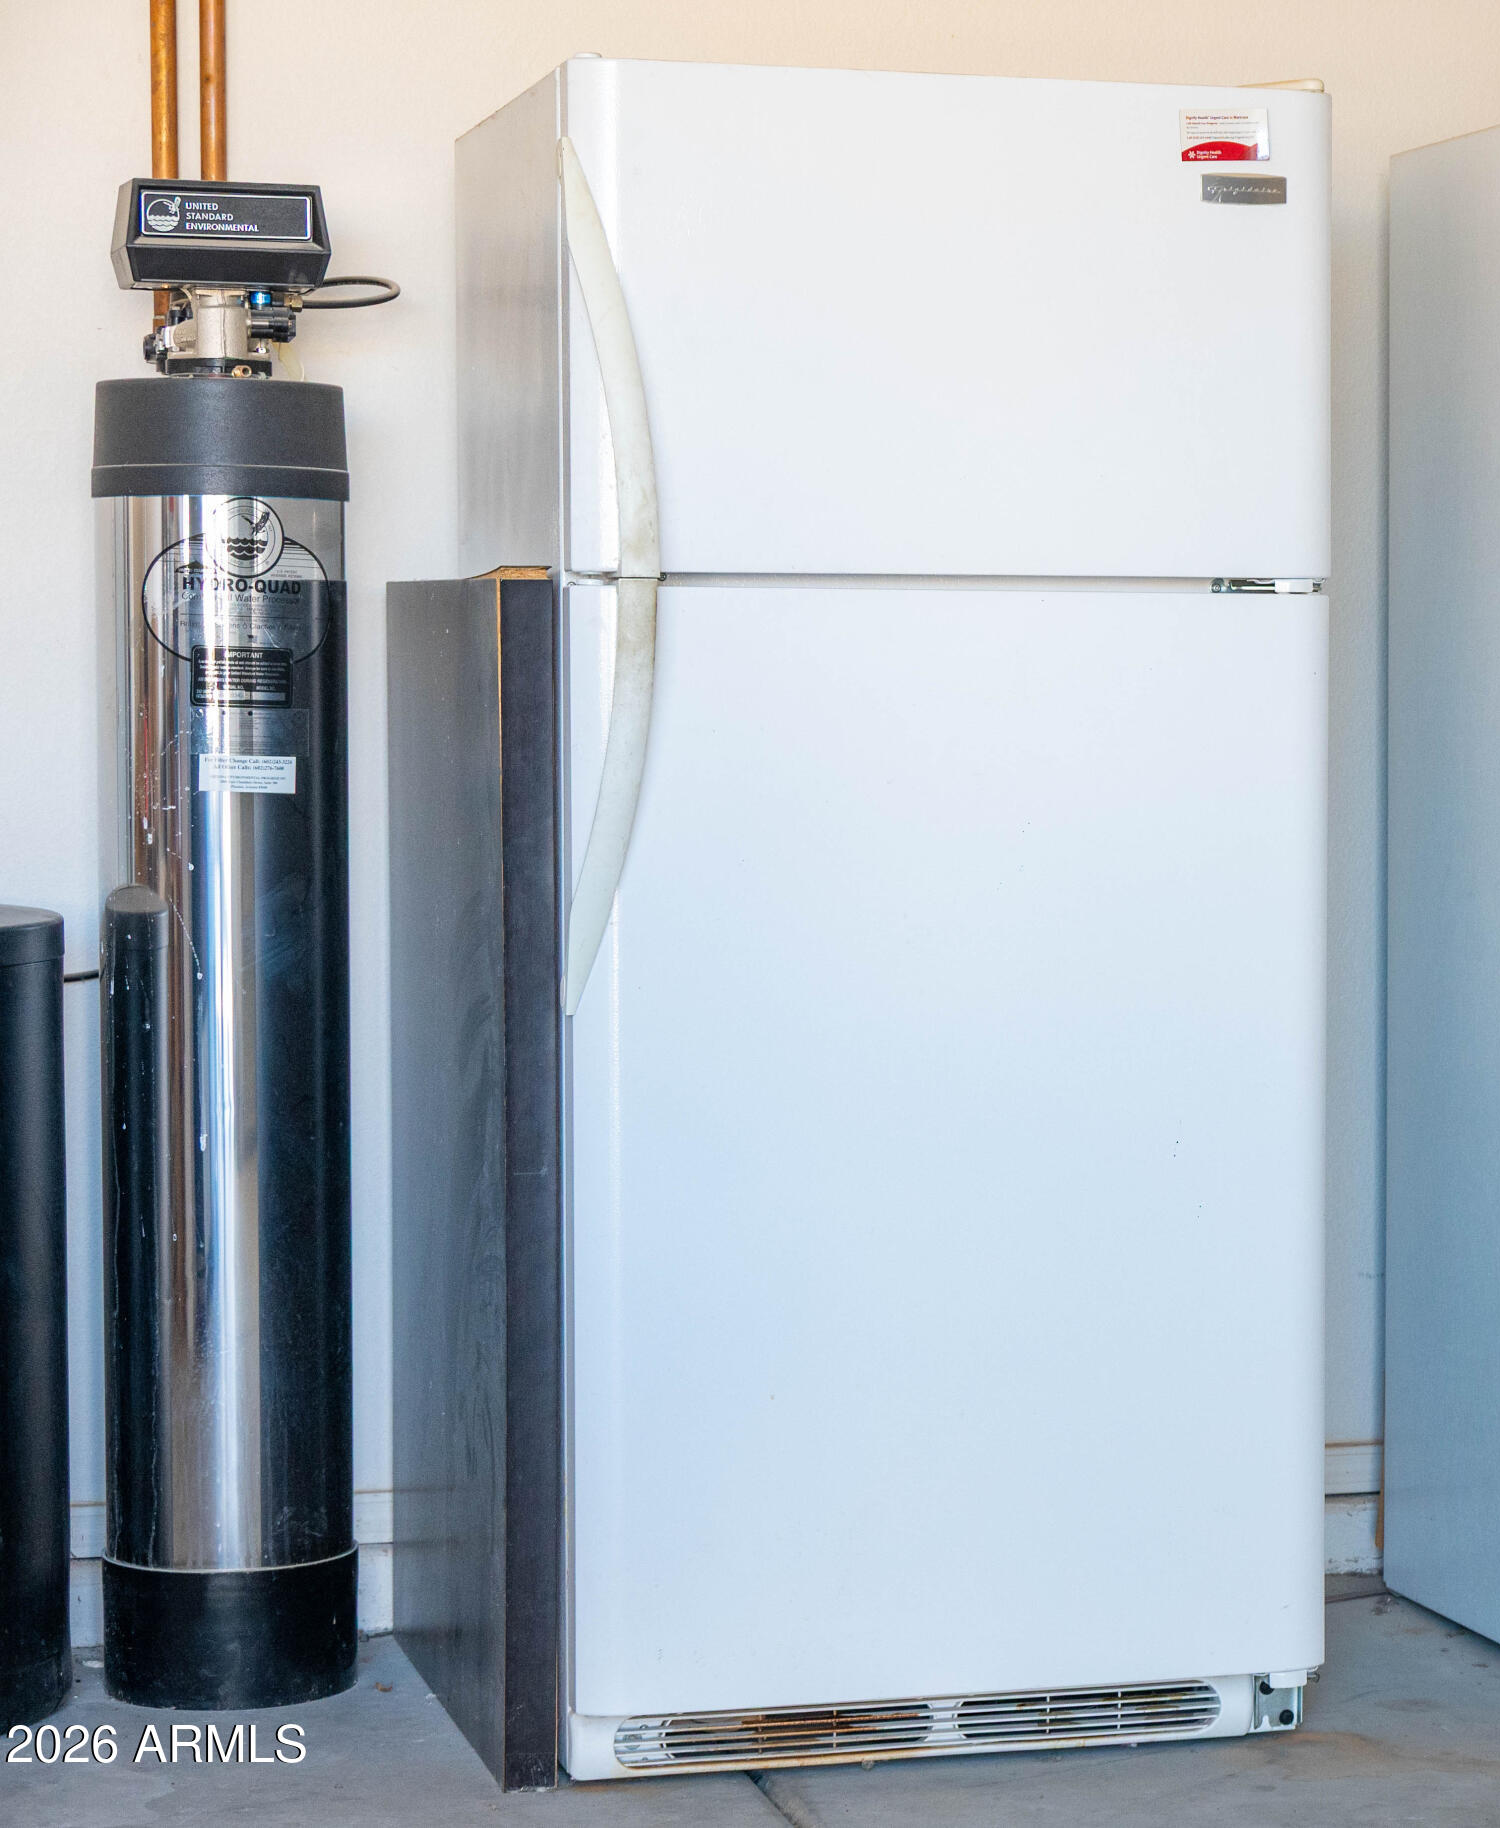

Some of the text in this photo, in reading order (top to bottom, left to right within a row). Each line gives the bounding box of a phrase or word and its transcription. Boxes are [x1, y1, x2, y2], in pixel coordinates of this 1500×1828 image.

[185, 201, 219, 211] UNITED
[185, 211, 234, 221] STANDARD
[185, 222, 259, 232] ENVIRONMENTAL
